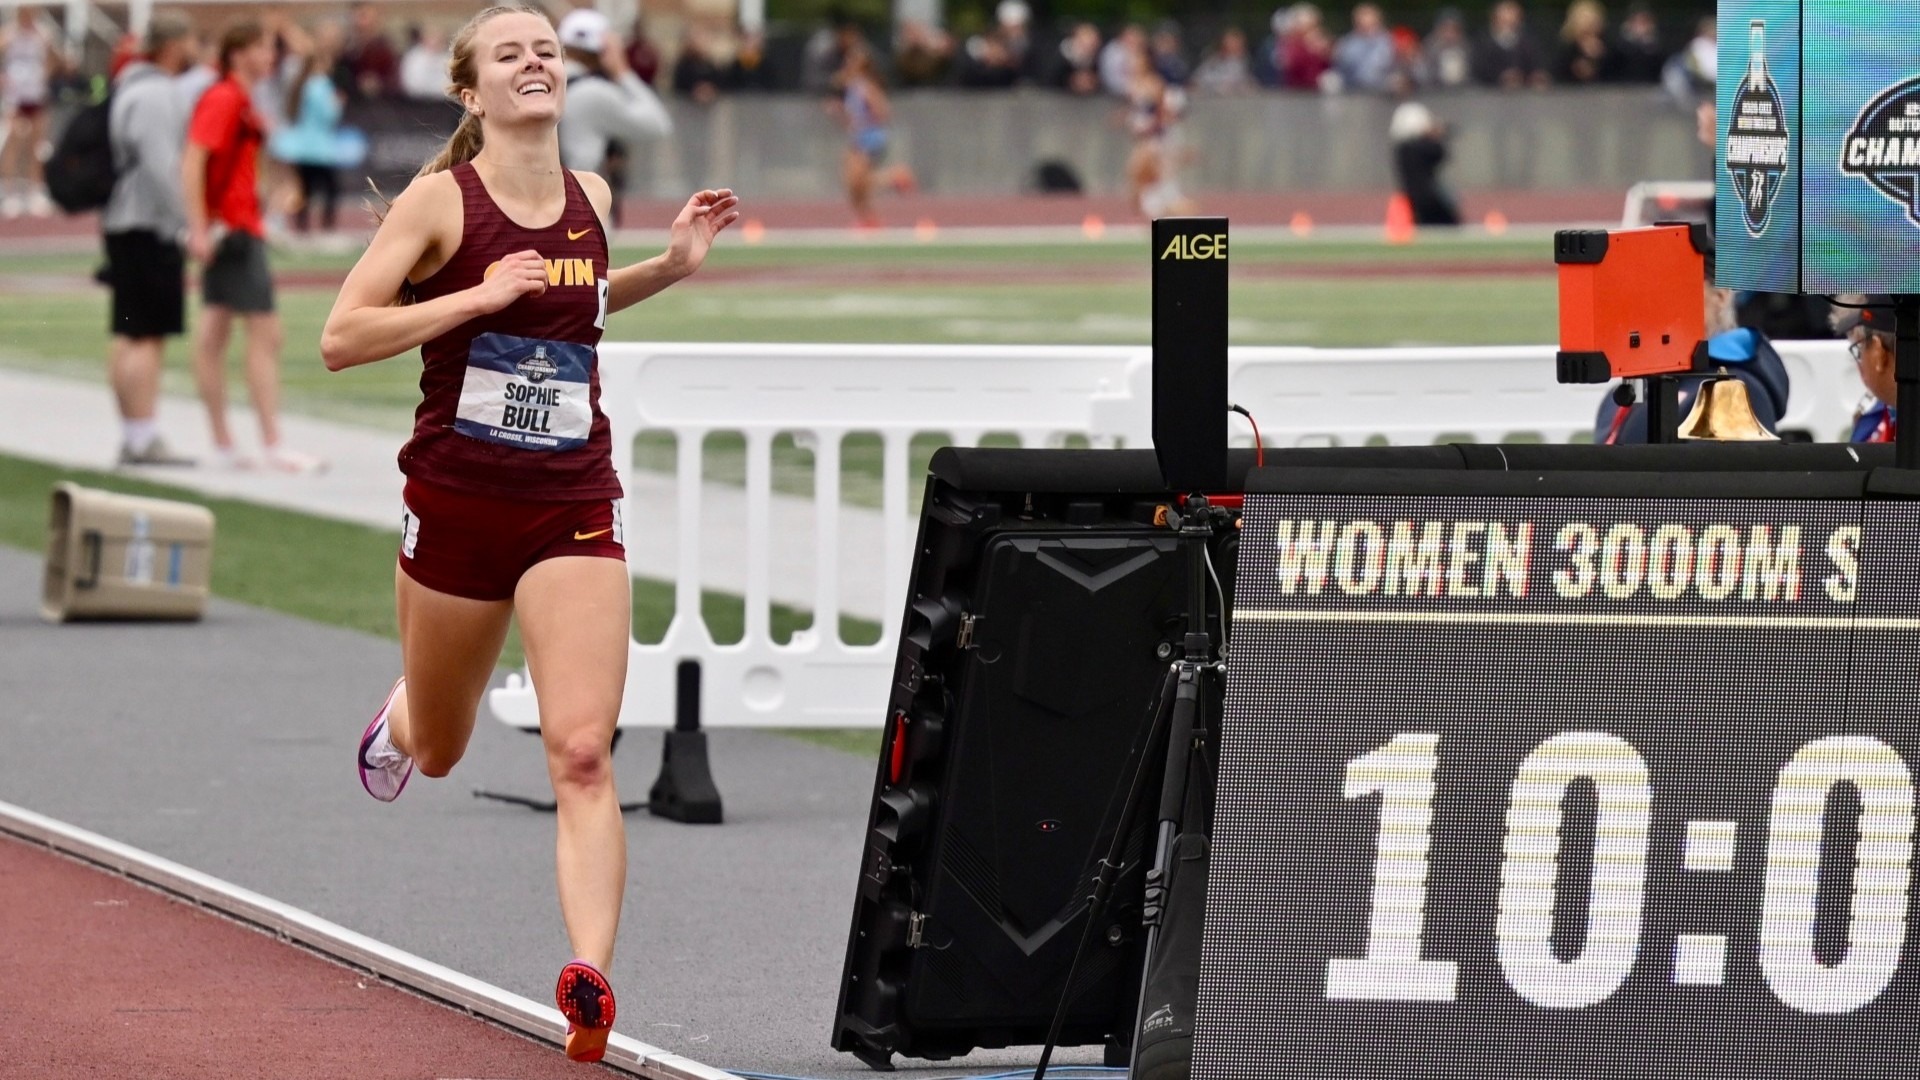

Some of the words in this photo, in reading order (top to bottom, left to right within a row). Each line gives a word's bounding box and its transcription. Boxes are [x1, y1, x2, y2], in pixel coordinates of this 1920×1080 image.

[1160, 233, 1227, 260] ALGE
[504, 382, 561, 407] SOPHIE
[501, 404, 551, 433] BULL
[489, 428, 498, 437] LA
[525, 435, 558, 447] WISCONSIN
[1276, 519, 1535, 598] WOMEN
[1551, 523, 1802, 601] 3000M
[1326, 731, 1917, 1015] 10:0
